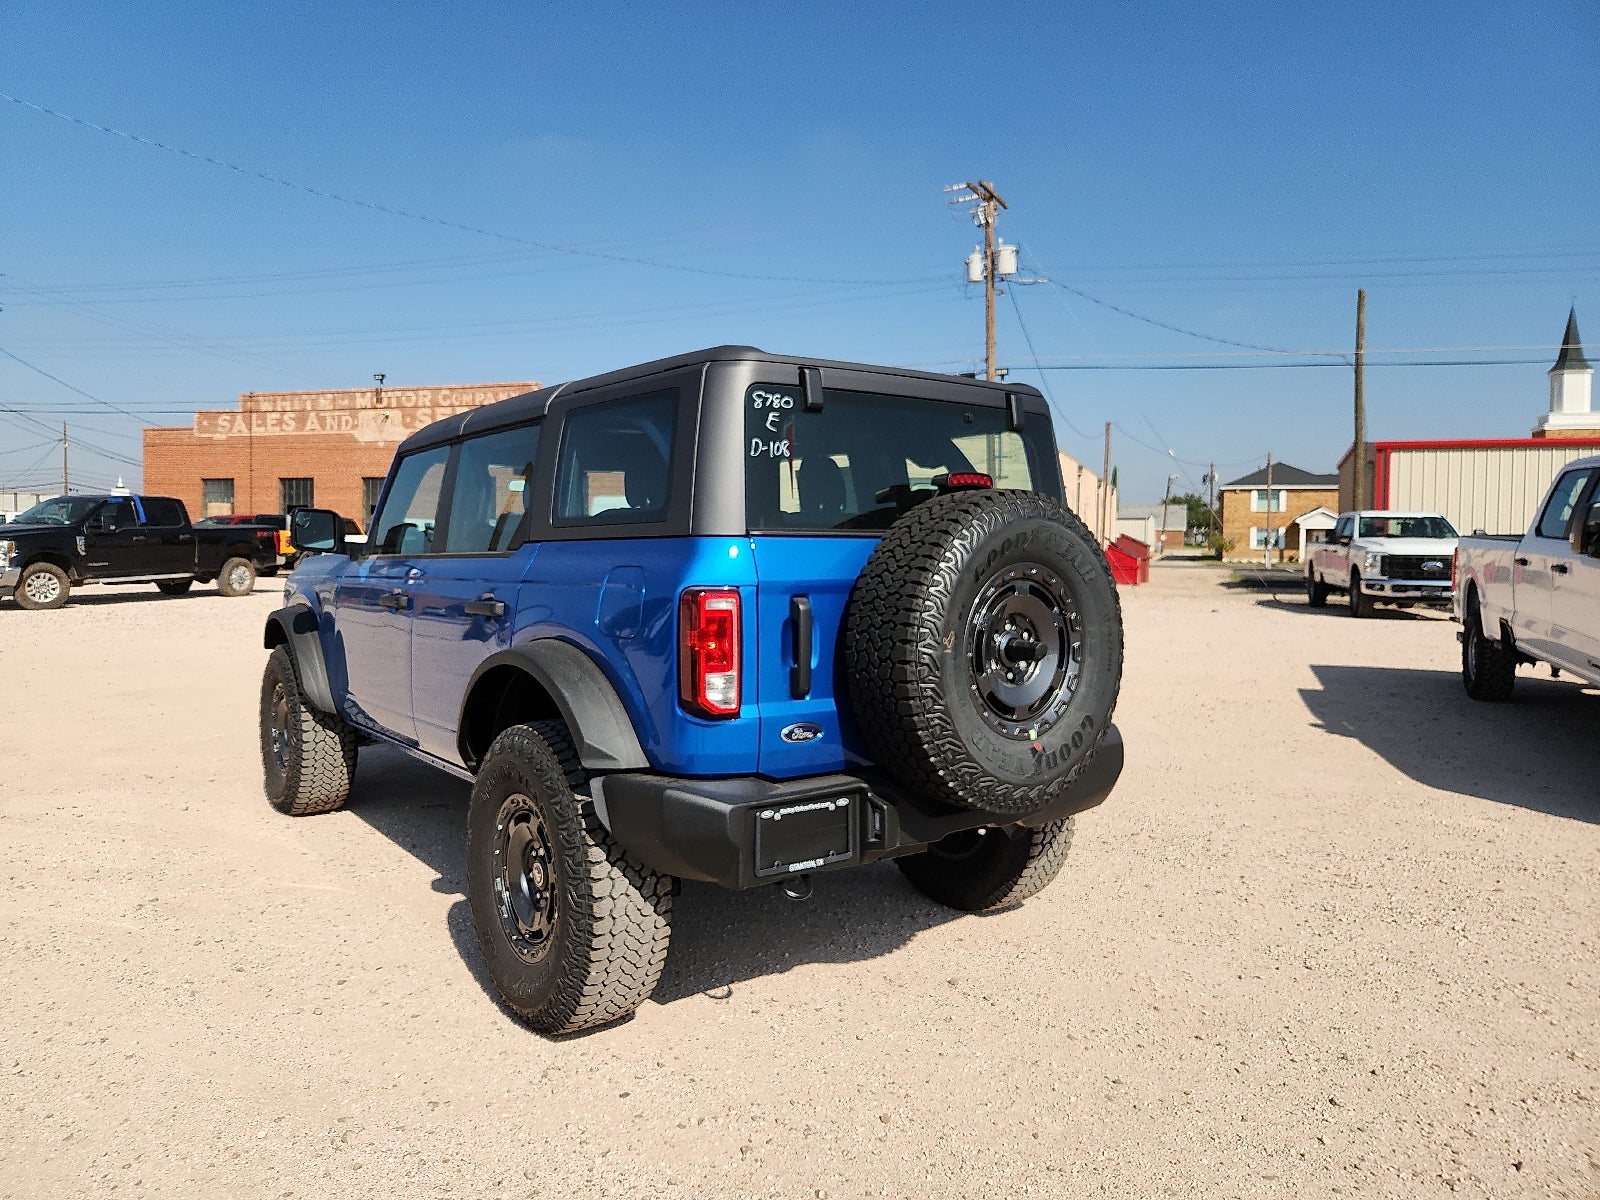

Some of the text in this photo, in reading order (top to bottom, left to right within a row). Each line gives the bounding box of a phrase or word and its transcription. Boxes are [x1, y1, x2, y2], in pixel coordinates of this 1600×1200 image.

[355, 390, 432, 408] MOTOR
[752, 390, 794, 409] 8780
[216, 412, 296, 434] SALES
[305, 411, 352, 433] AND
[765, 411, 780, 432] E
[750, 437, 790, 458] D-108
